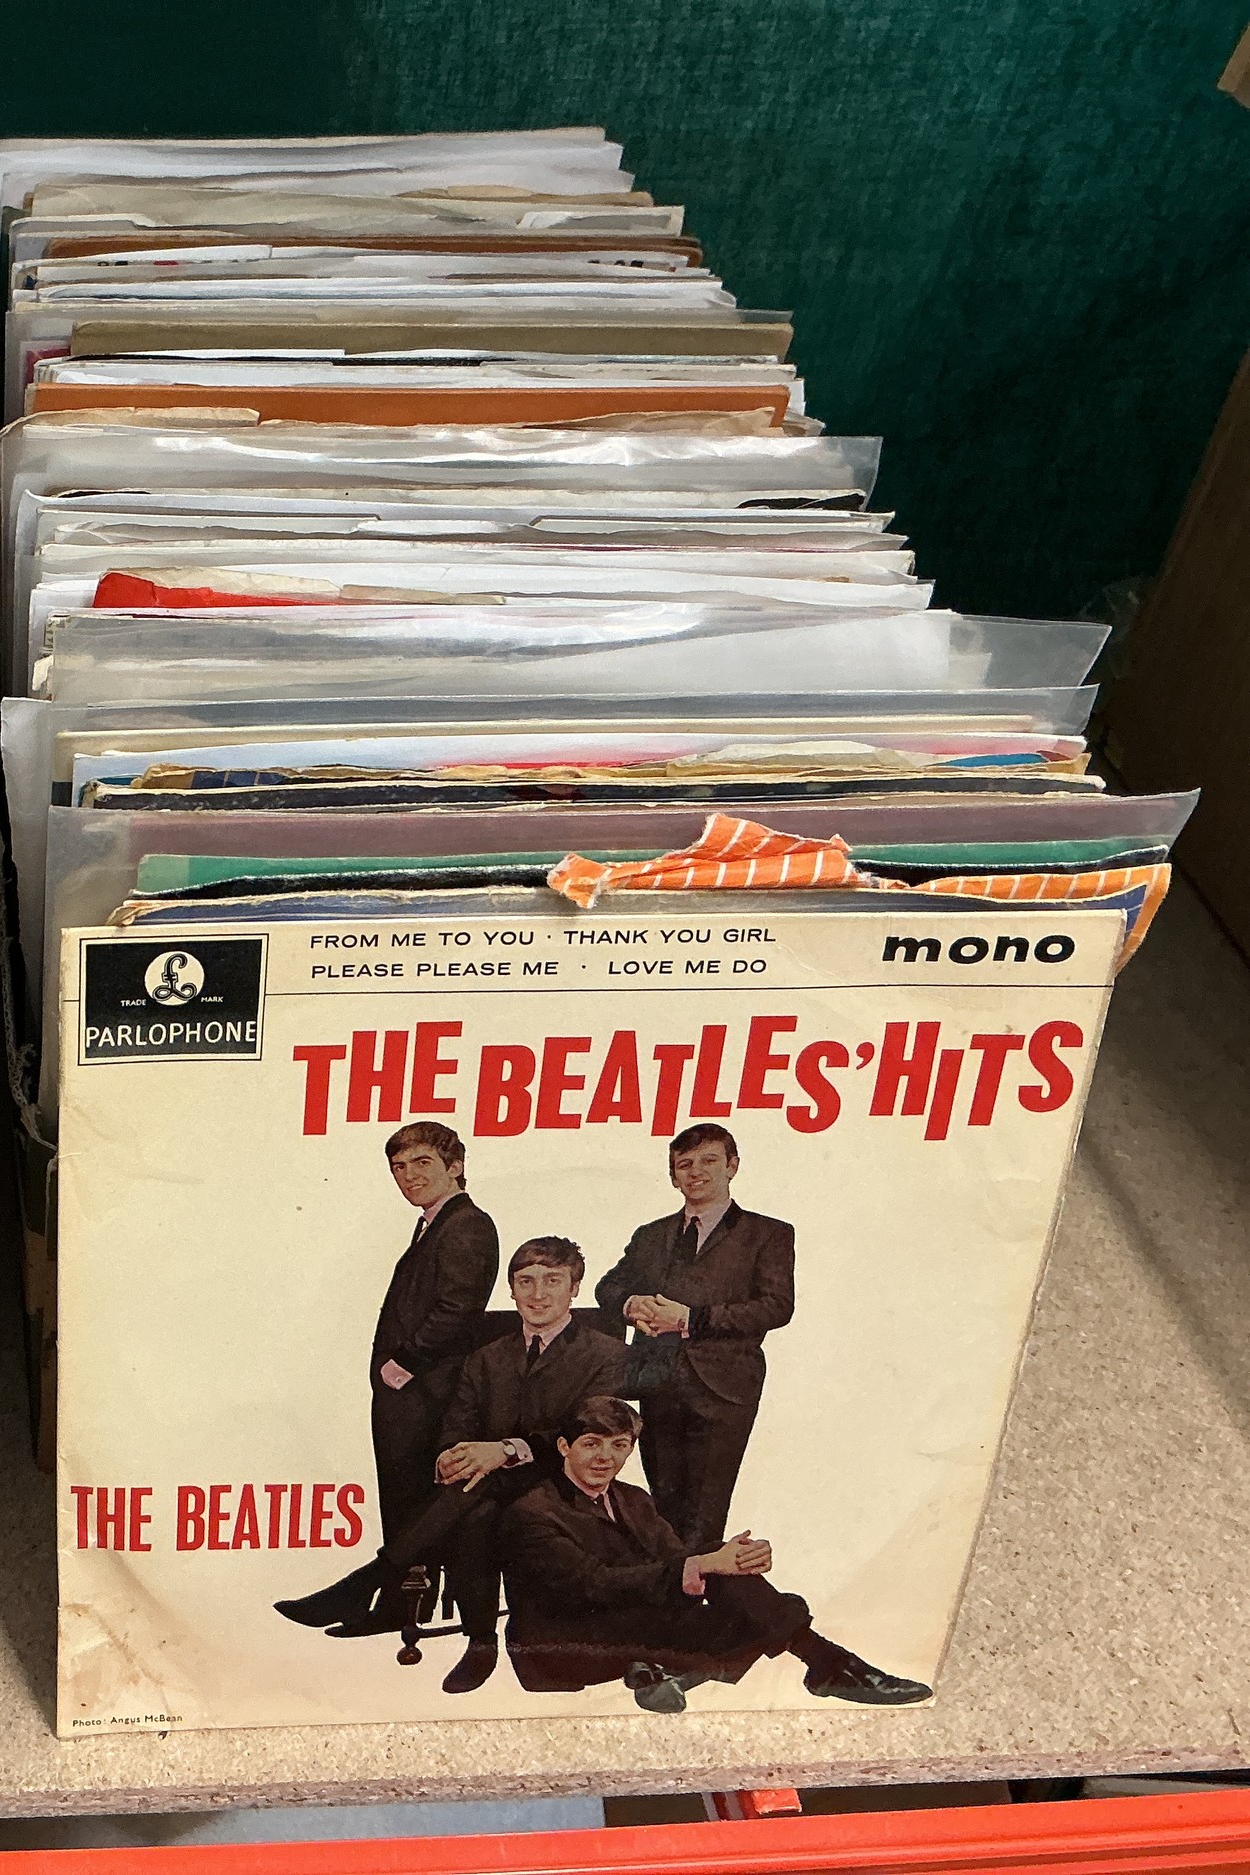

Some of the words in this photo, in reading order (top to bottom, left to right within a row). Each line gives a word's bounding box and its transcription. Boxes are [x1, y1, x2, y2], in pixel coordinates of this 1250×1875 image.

[310, 934, 379, 949] FROM
[391, 933, 426, 947] ME
[438, 932, 471, 946] TO
[483, 931, 534, 945] YOU
[564, 930, 648, 944] THANK
[660, 929, 711, 943] YOU
[723, 928, 776, 943] GIRL
[882, 933, 1076, 964] mono
[311, 963, 404, 978] PLEASE
[416, 962, 511, 977] PLEASE
[523, 962, 559, 975] ME
[608, 961, 673, 975] LOVE
[685, 960, 721, 974] ME
[733, 959, 767, 973] DO
[120, 999, 146, 1007] TRADE
[86, 1020, 257, 1048] PARLOPHONE
[293, 1021, 463, 1136] THE
[71, 1485, 153, 1552] THE
[176, 1483, 365, 1551] BEATLES
[110, 1716, 141, 1725] Angus
[145, 1714, 183, 1723] McBean
